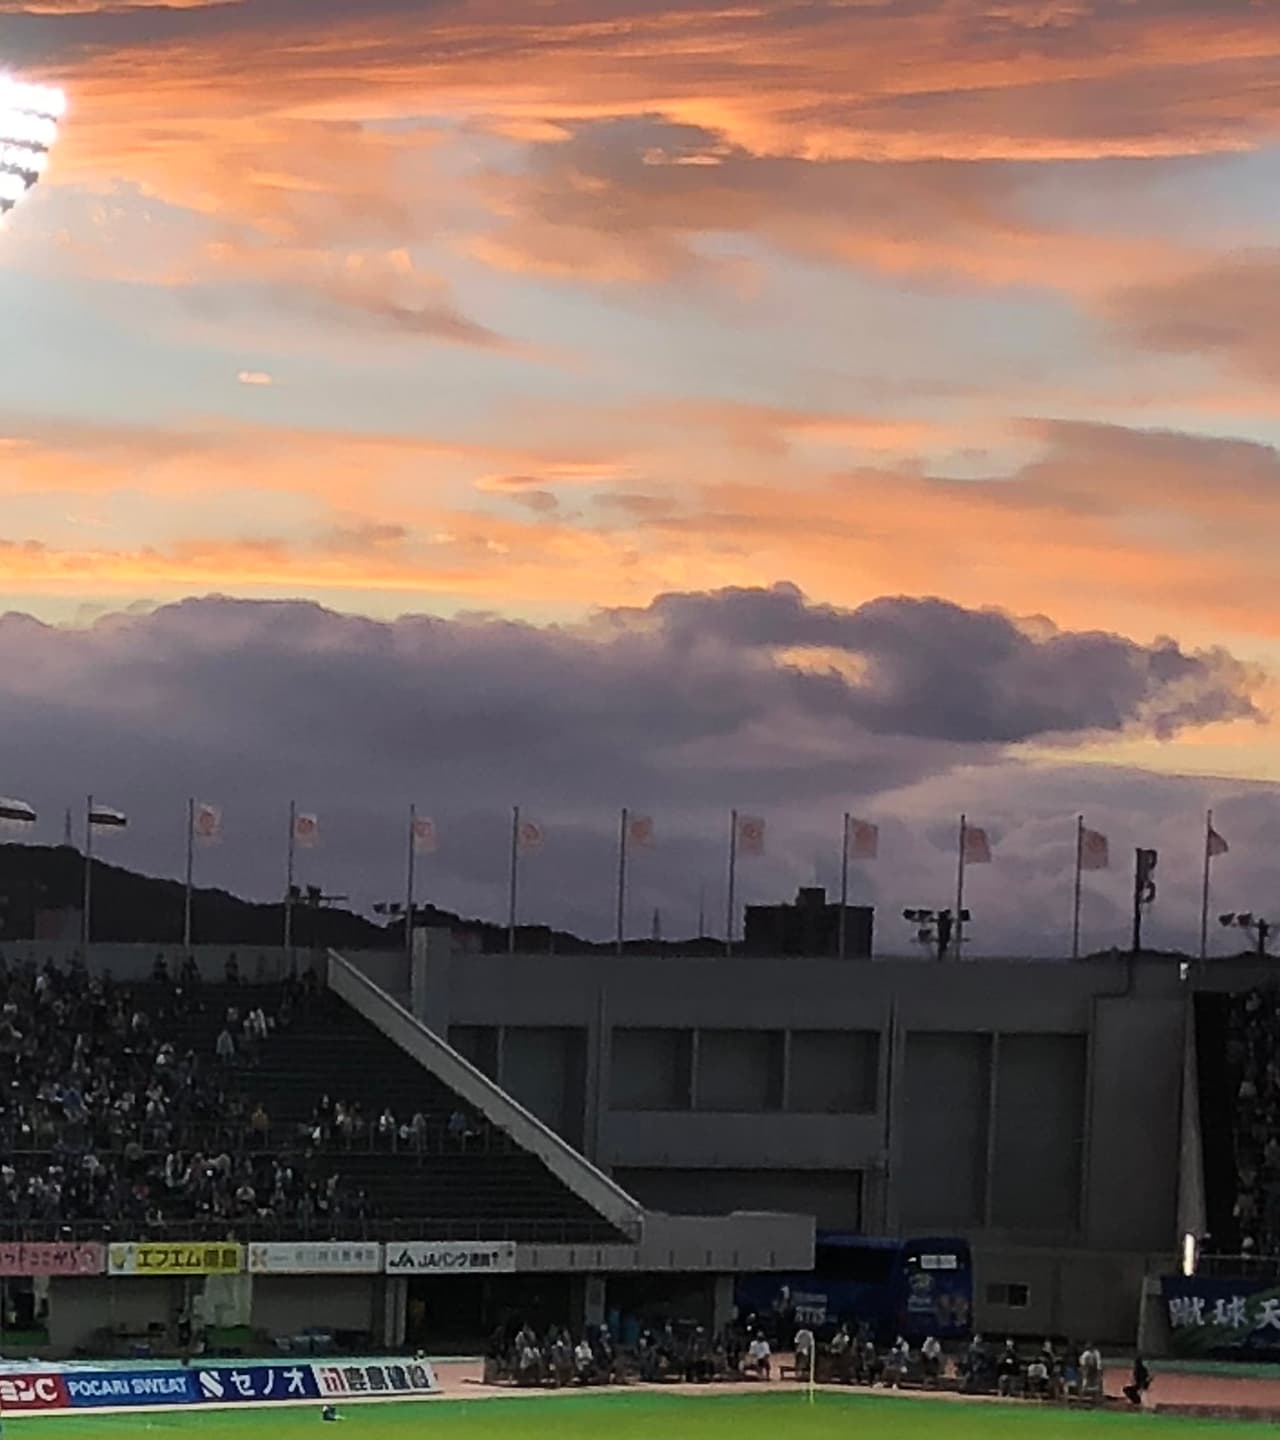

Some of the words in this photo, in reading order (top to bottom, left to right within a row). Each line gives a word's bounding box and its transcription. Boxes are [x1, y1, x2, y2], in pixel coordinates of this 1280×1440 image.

[68, 1379, 130, 1397] POCARI
[131, 1376, 188, 1395] SWEAT
[230, 1367, 306, 1396] セノオ
